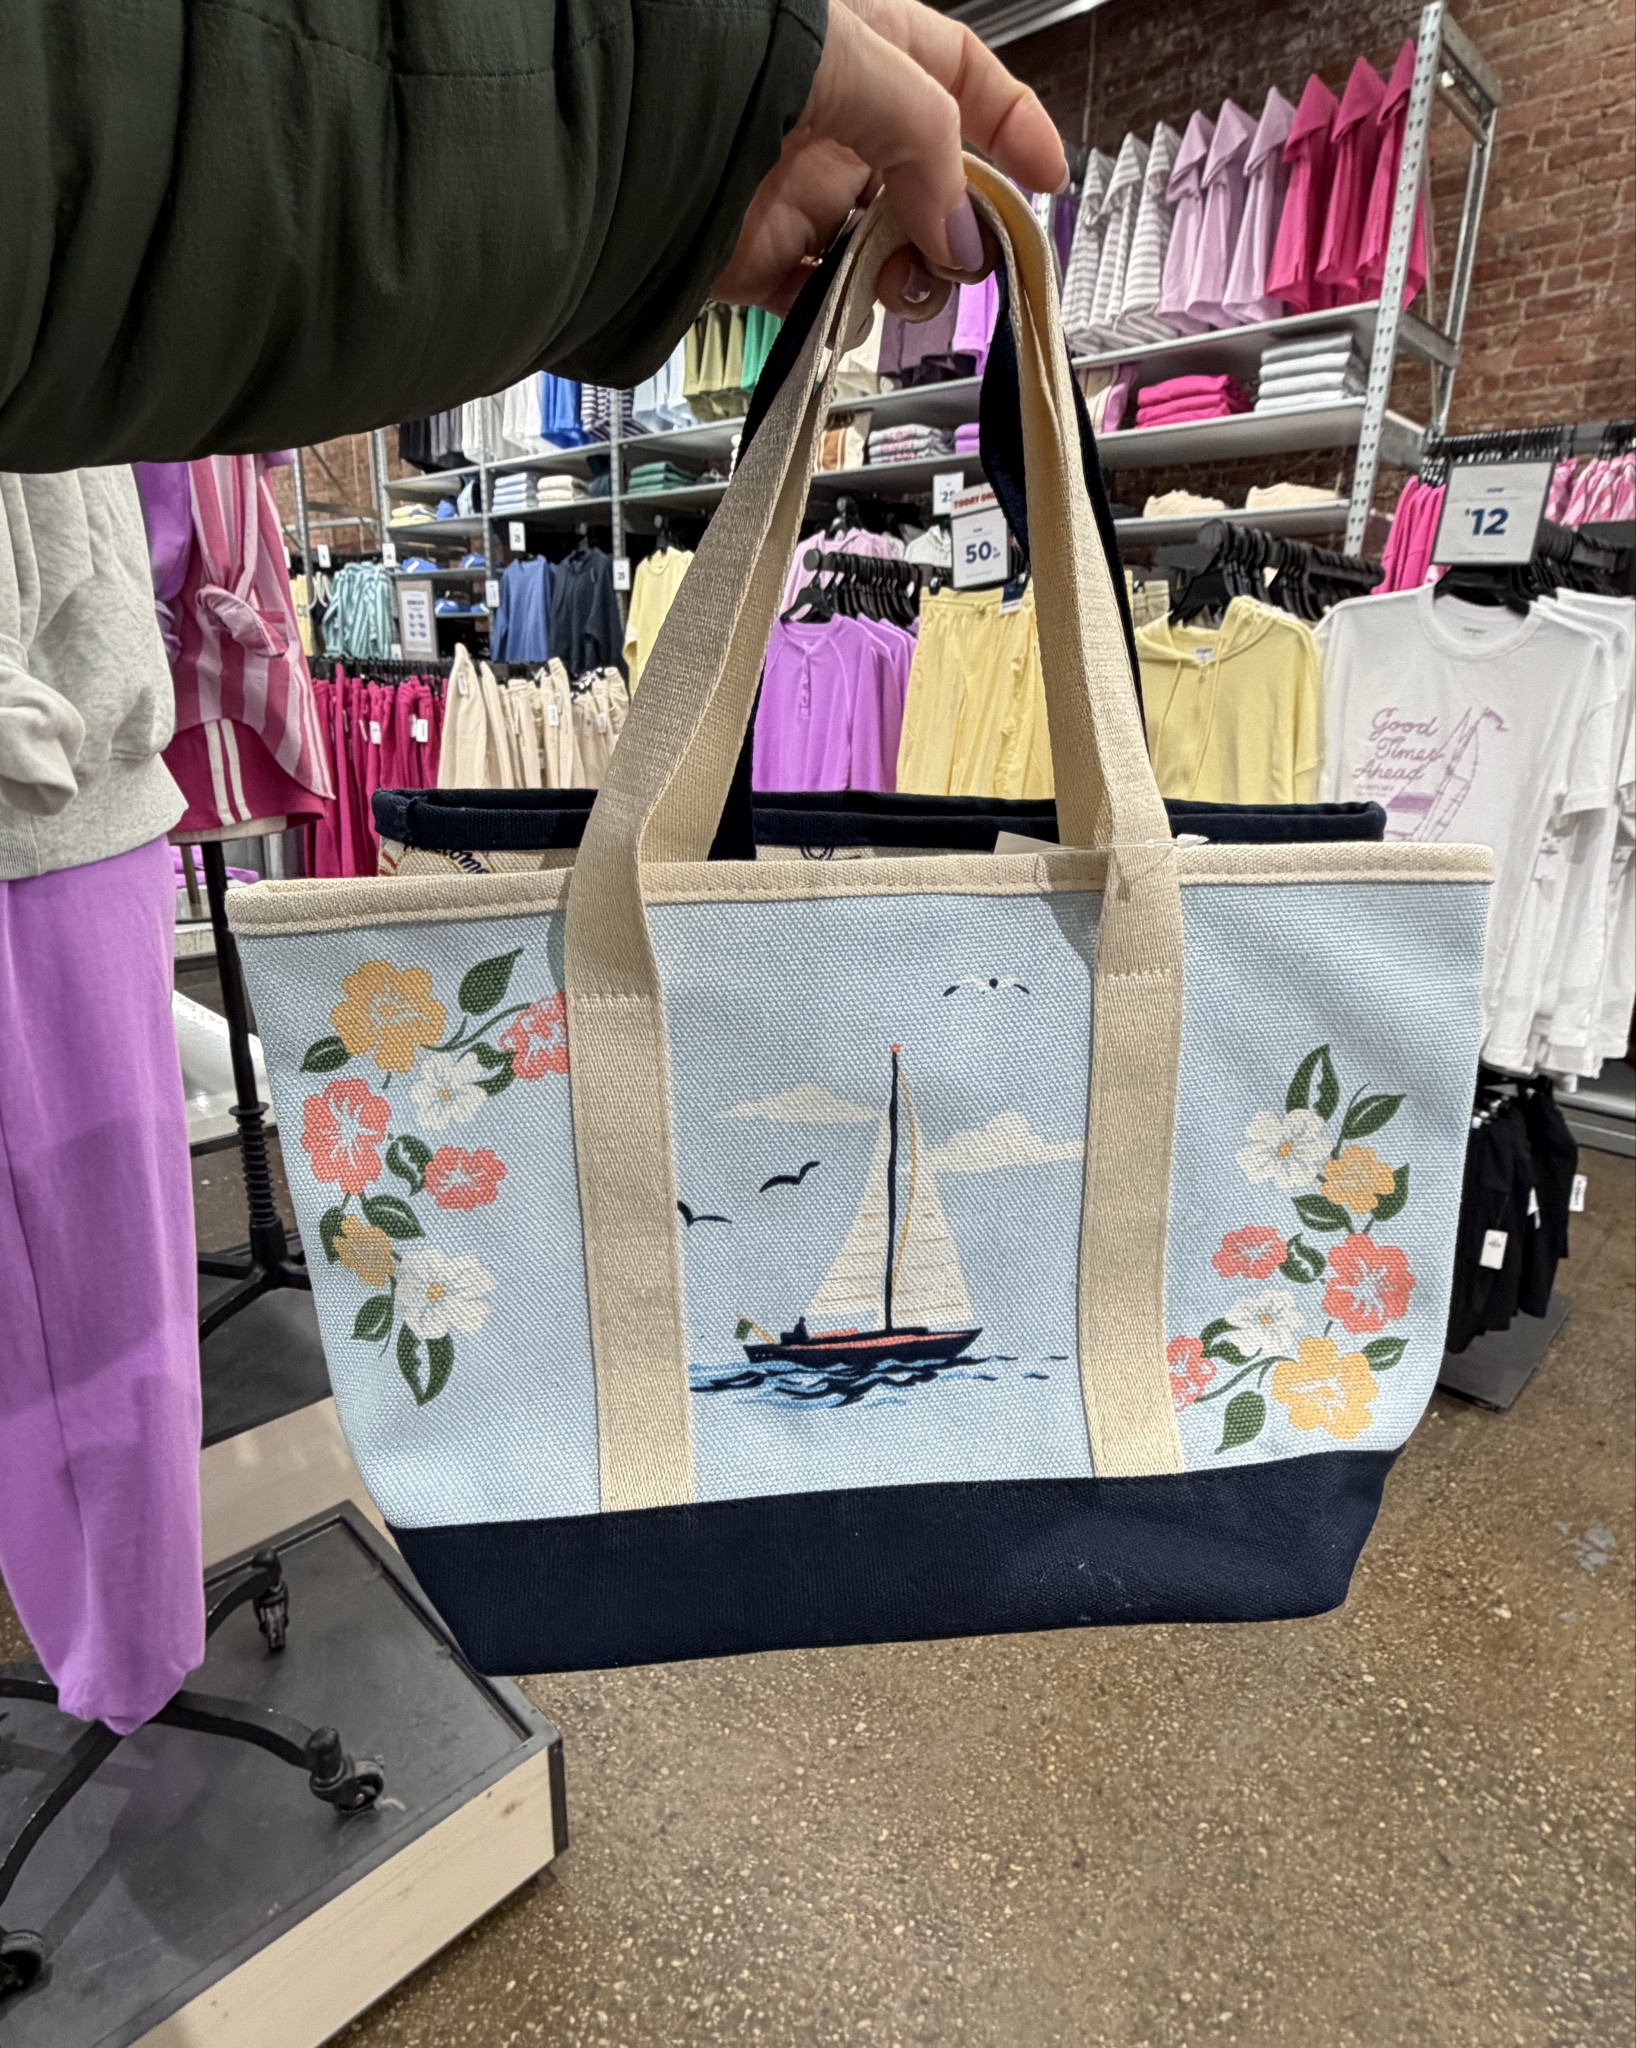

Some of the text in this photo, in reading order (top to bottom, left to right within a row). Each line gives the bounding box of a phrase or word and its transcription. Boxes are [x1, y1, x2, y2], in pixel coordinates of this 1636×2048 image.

[1369, 707, 1438, 741] Good
[1374, 736, 1445, 761] Times
[1352, 759, 1425, 780] Ahead
